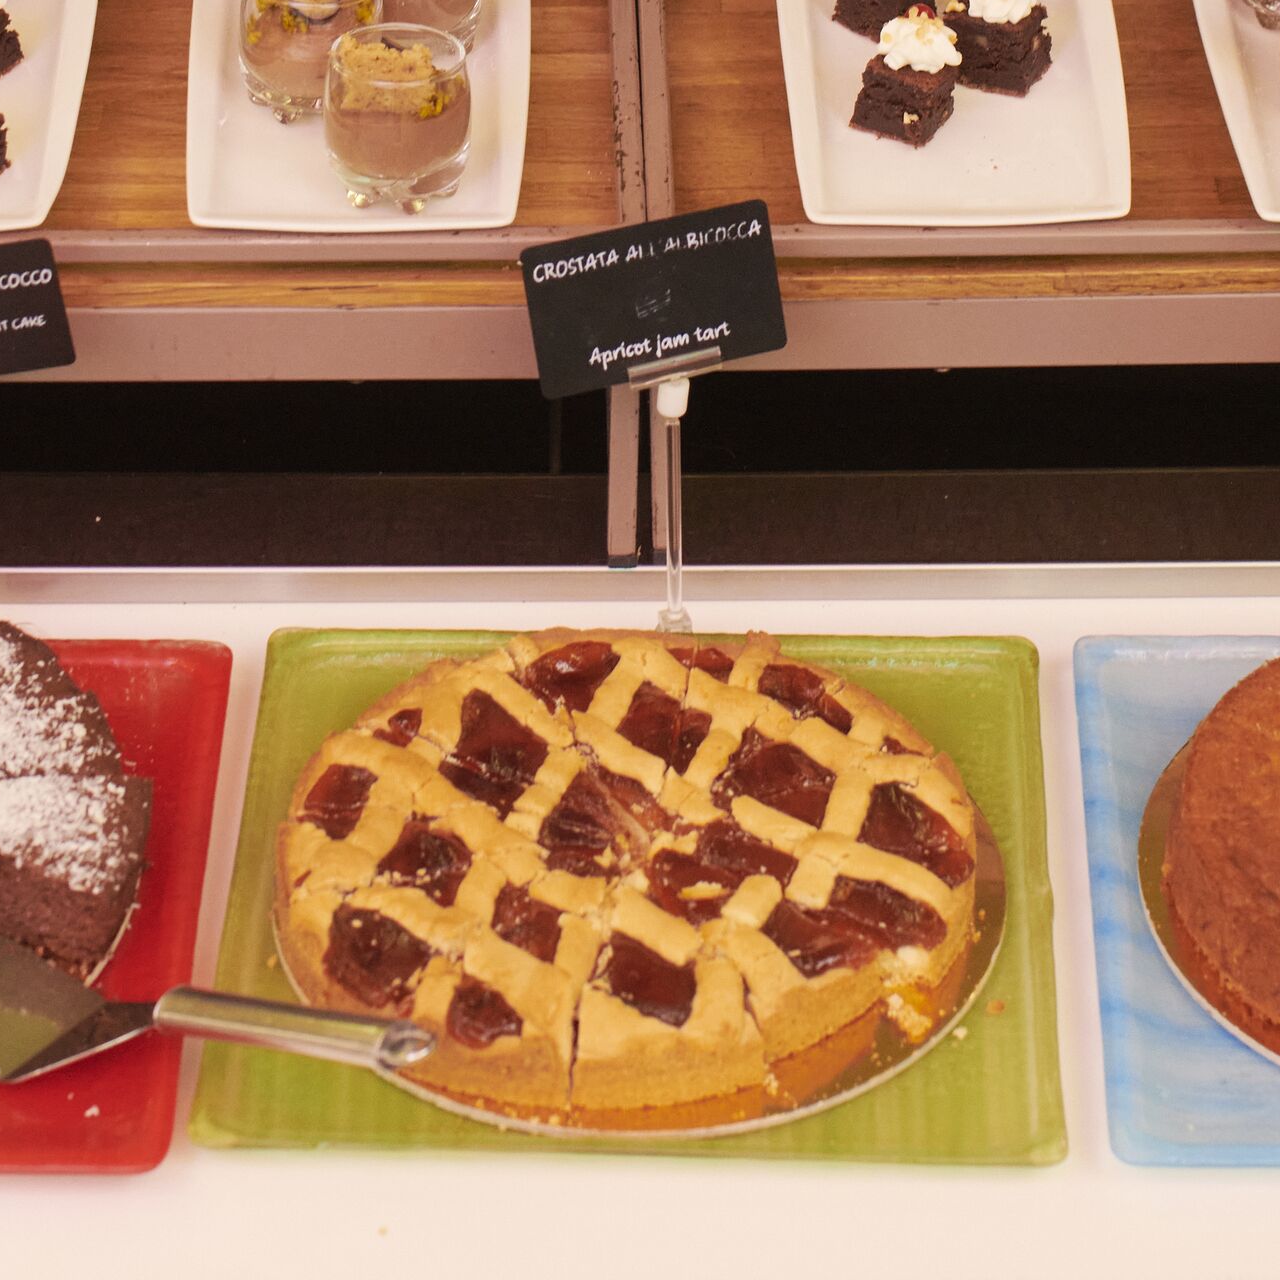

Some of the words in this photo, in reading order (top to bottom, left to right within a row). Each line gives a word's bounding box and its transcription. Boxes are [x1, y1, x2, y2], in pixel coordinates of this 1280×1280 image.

[533, 249, 620, 283] CROSTATA
[11, 315, 46, 330] CAKE
[589, 337, 652, 370] Apricot
[656, 332, 690, 357] jam
[694, 322, 731, 342] tart
